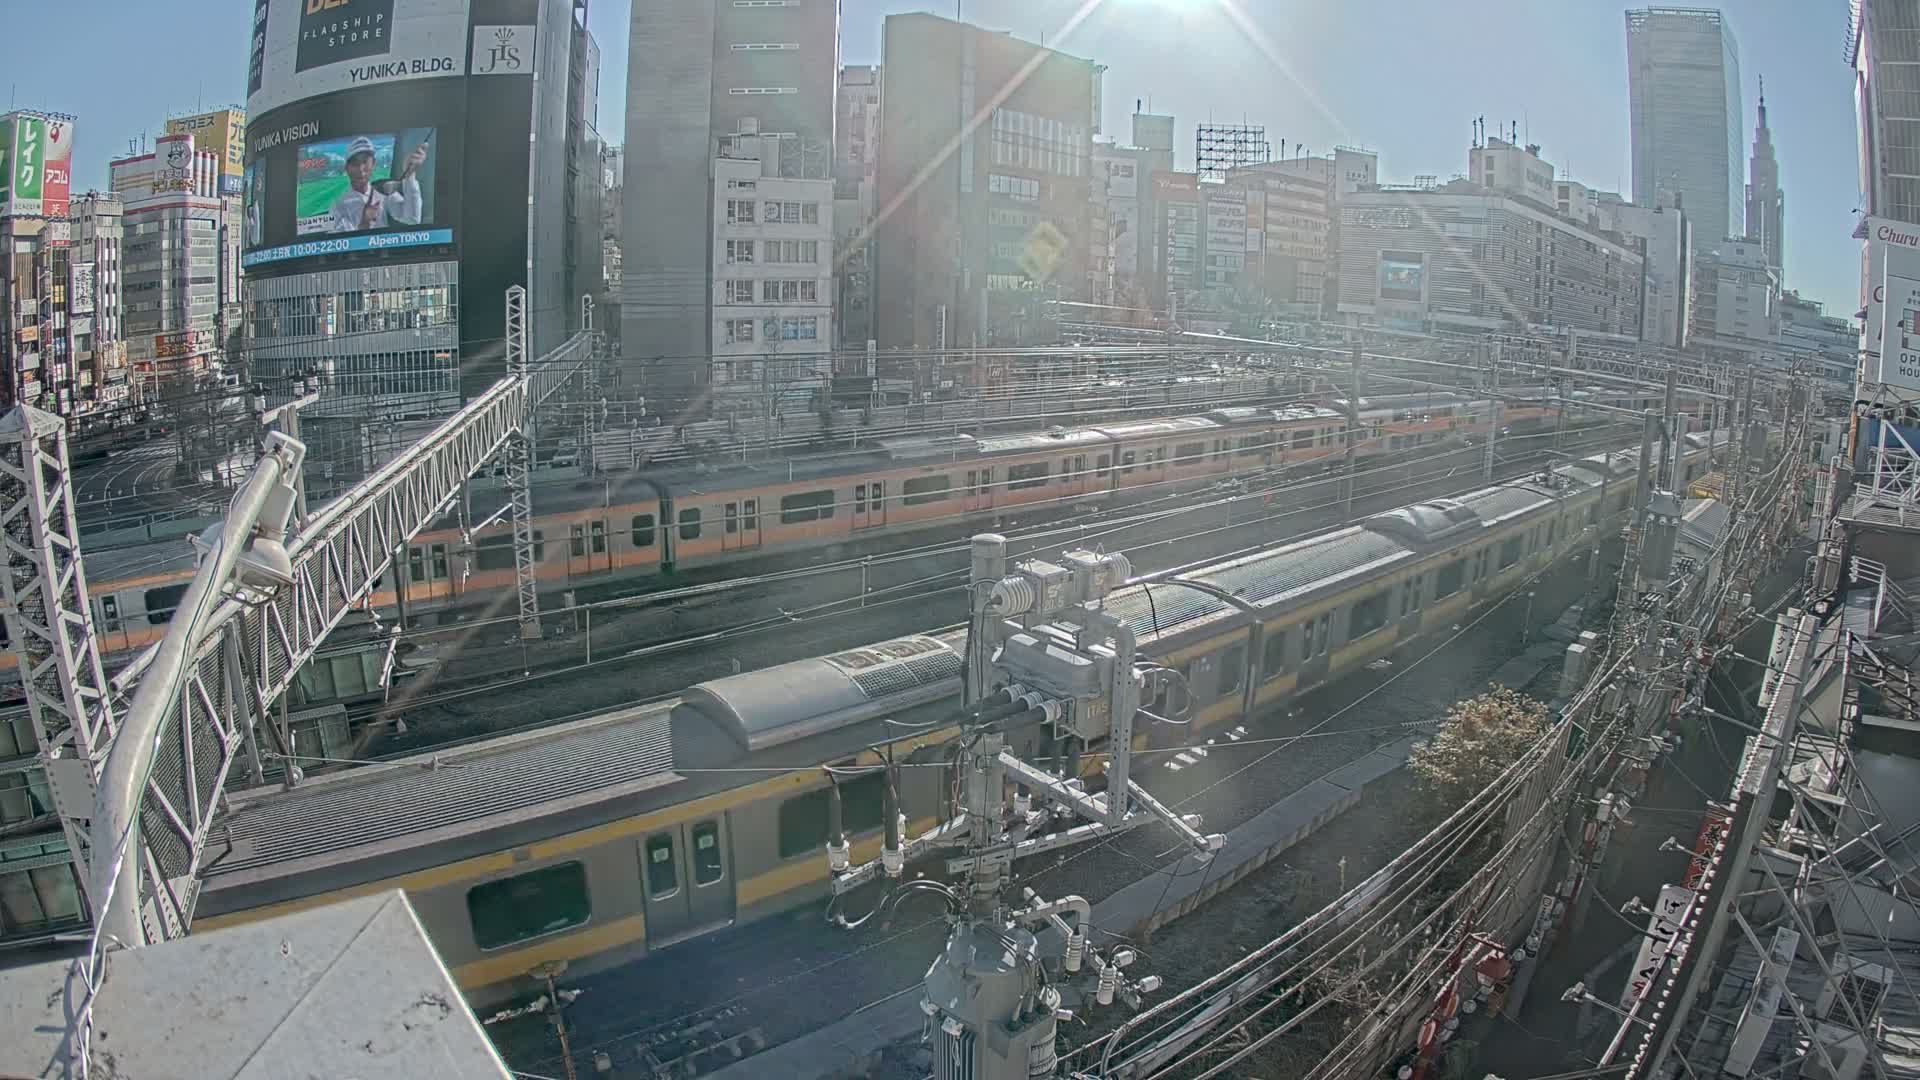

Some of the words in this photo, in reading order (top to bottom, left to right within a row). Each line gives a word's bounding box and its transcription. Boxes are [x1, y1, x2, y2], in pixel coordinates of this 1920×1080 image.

[304, 14, 383, 40] FLAGSHIP
[329, 28, 382, 47] STORE
[350, 63, 407, 83] YUNIKA
[411, 57, 456, 74] BLDG.
[255, 131, 281, 152] YUNIKA
[282, 120, 320, 142] VISION
[21, 120, 37, 187] レイク
[46, 168, 68, 185] アコム
[294, 239, 350, 256] 10:00-22:00
